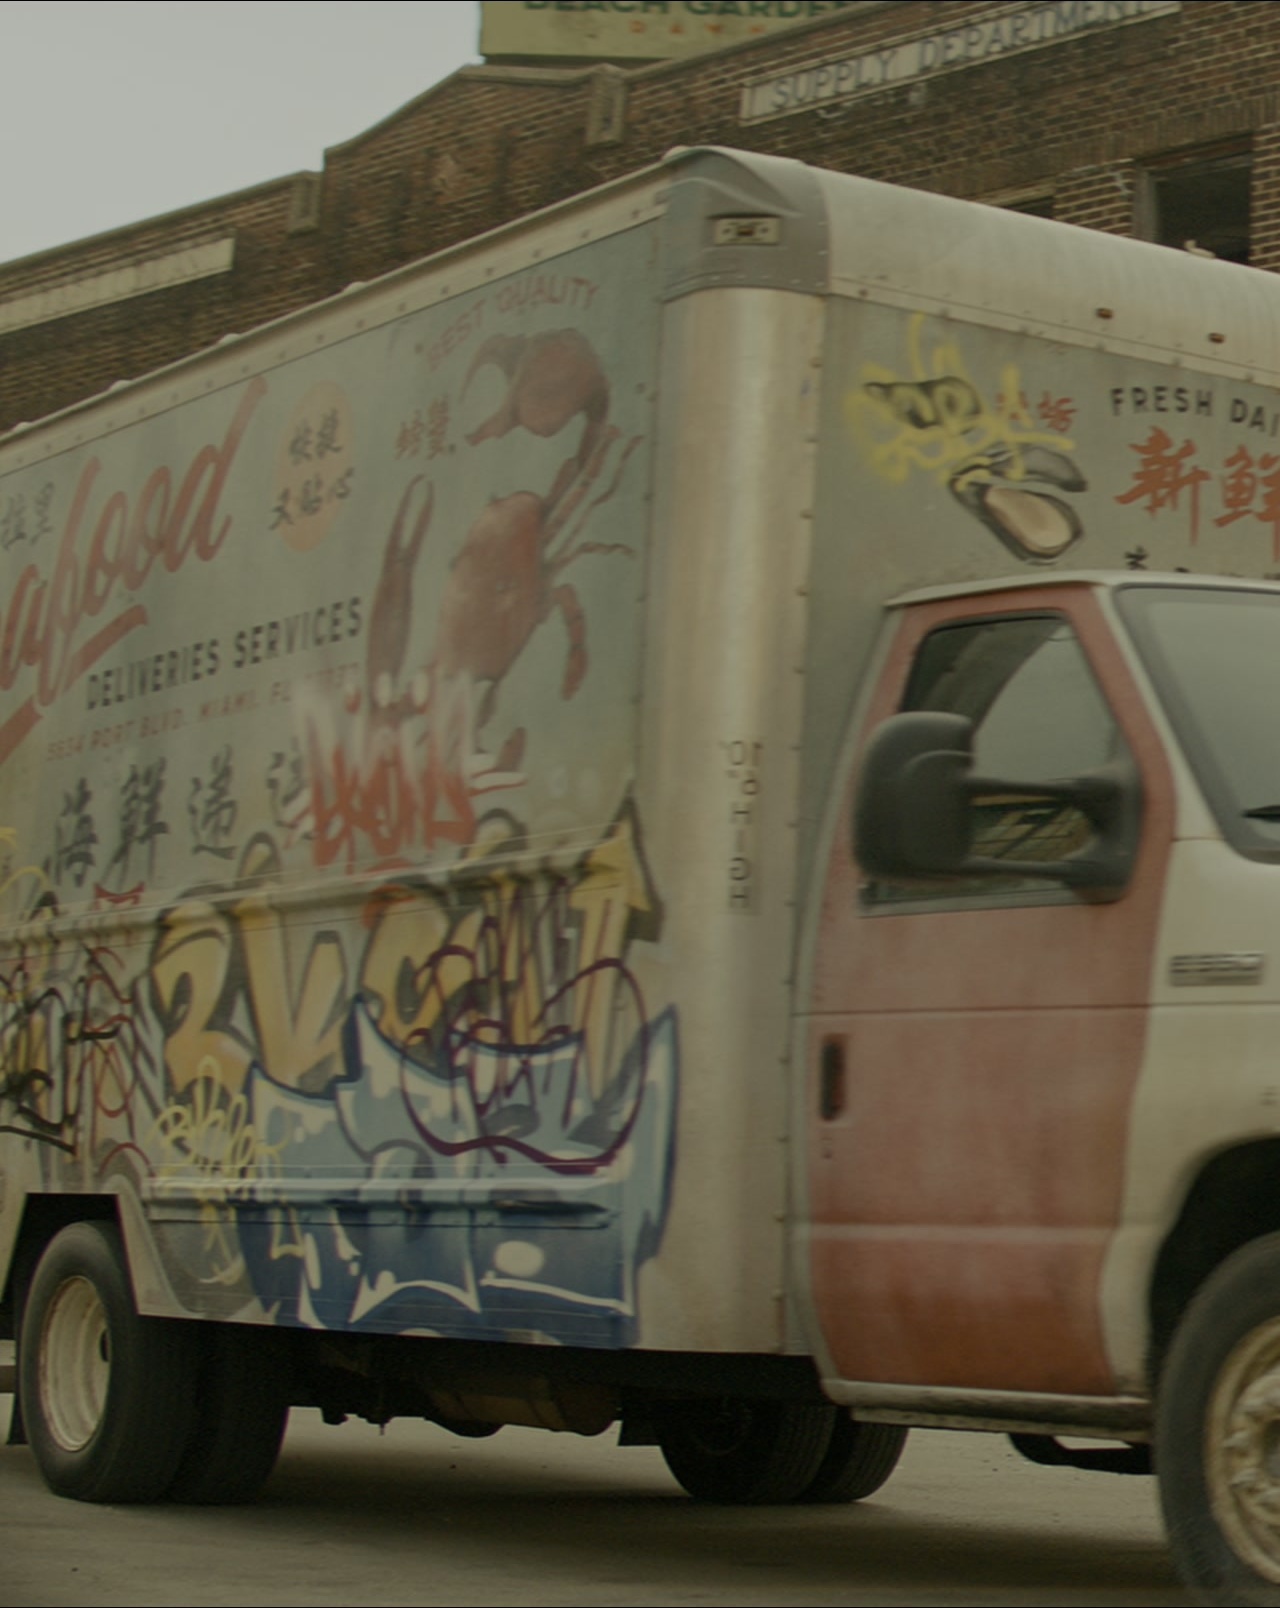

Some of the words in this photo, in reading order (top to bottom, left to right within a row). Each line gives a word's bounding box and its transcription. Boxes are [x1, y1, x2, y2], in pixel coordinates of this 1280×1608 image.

[685, 1, 848, 18] GARDE
[772, 51, 898, 108] SUPPLY
[427, 298, 488, 373] BEST
[496, 274, 600, 313] QUALITY
[1108, 384, 1215, 418] FRESH
[85, 637, 221, 711] DELIVERIES
[233, 596, 362, 669] SERVICES
